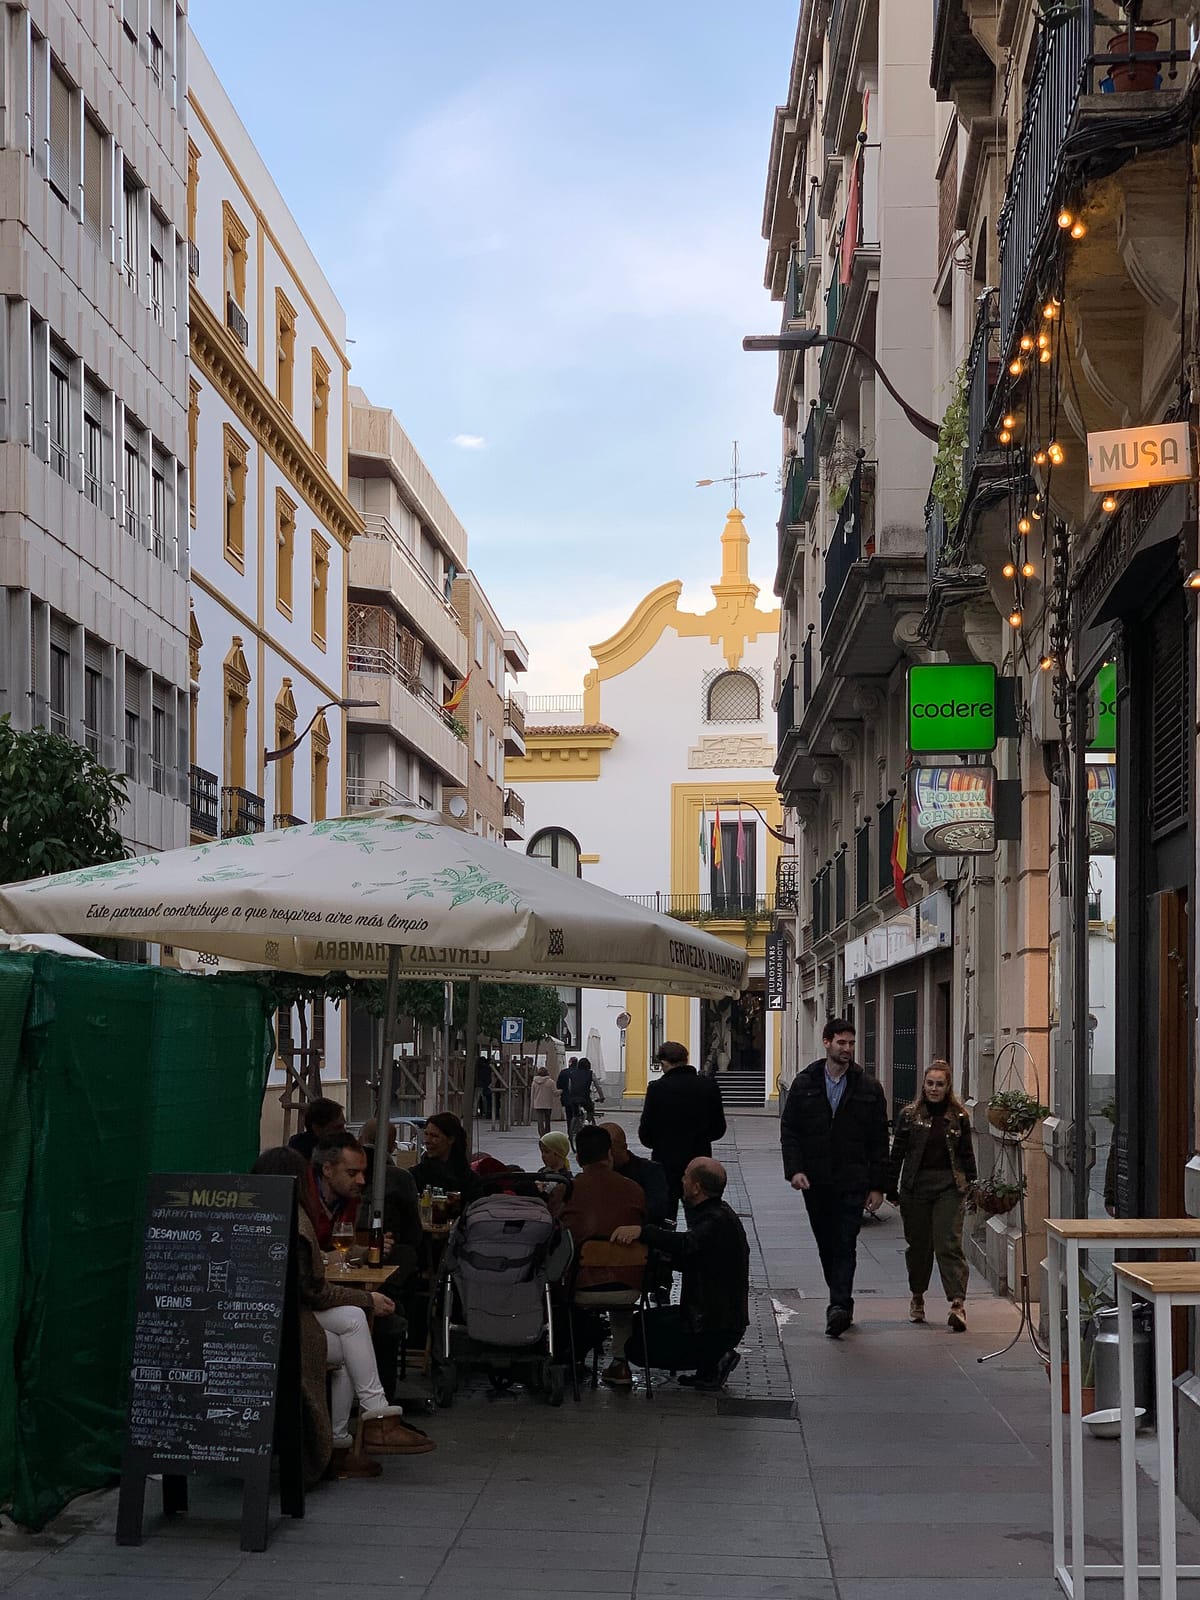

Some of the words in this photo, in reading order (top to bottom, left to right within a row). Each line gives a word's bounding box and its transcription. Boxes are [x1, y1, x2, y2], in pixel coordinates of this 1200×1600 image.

[1099, 438, 1178, 473] MUSA
[912, 700, 993, 718] codere
[925, 790, 986, 803] FORUM
[919, 807, 993, 826] CENTER
[86, 904, 110, 918] Este
[109, 903, 160, 921] parasol
[162, 901, 229, 924] contribuye
[231, 906, 242, 917] a
[244, 907, 268, 922] que
[269, 907, 323, 924] respires
[325, 912, 353, 925] aire
[355, 914, 384, 927] más
[387, 913, 428, 933] limpio
[669, 940, 706, 970] CERVEZAS
[768, 945, 776, 993] EUROSTARS
[505, 1020, 519, 1041] P
[191, 1189, 238, 1208] MUSA
[168, 1370, 202, 1382] COMER
